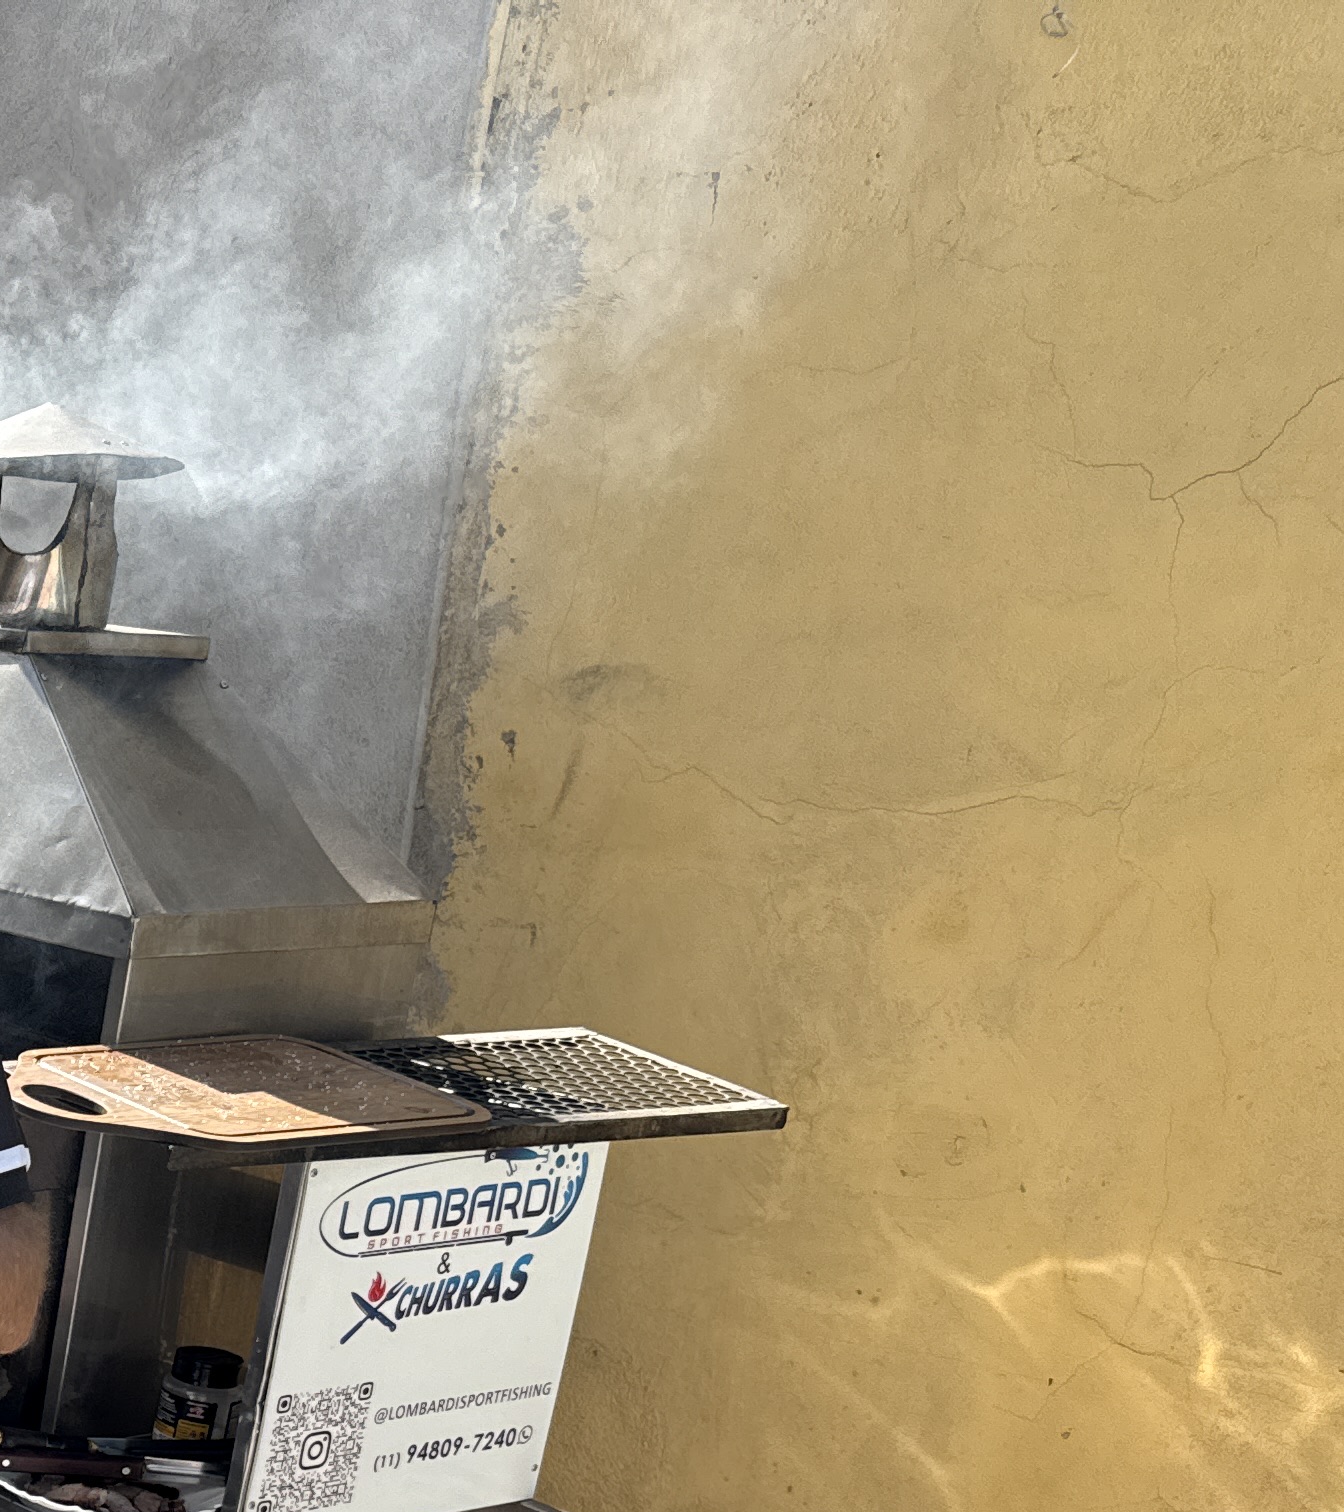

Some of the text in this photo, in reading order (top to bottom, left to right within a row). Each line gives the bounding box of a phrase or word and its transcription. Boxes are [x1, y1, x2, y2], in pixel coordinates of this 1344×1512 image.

[338, 1176, 561, 1241] LOMBARDI
[366, 1222, 505, 1250] SPORT FISHING
[436, 1251, 451, 1275] &
[373, 1381, 553, 1425] @LOMBARDISPORTFISHING
[373, 1427, 518, 1473] (11) 94809-7240
